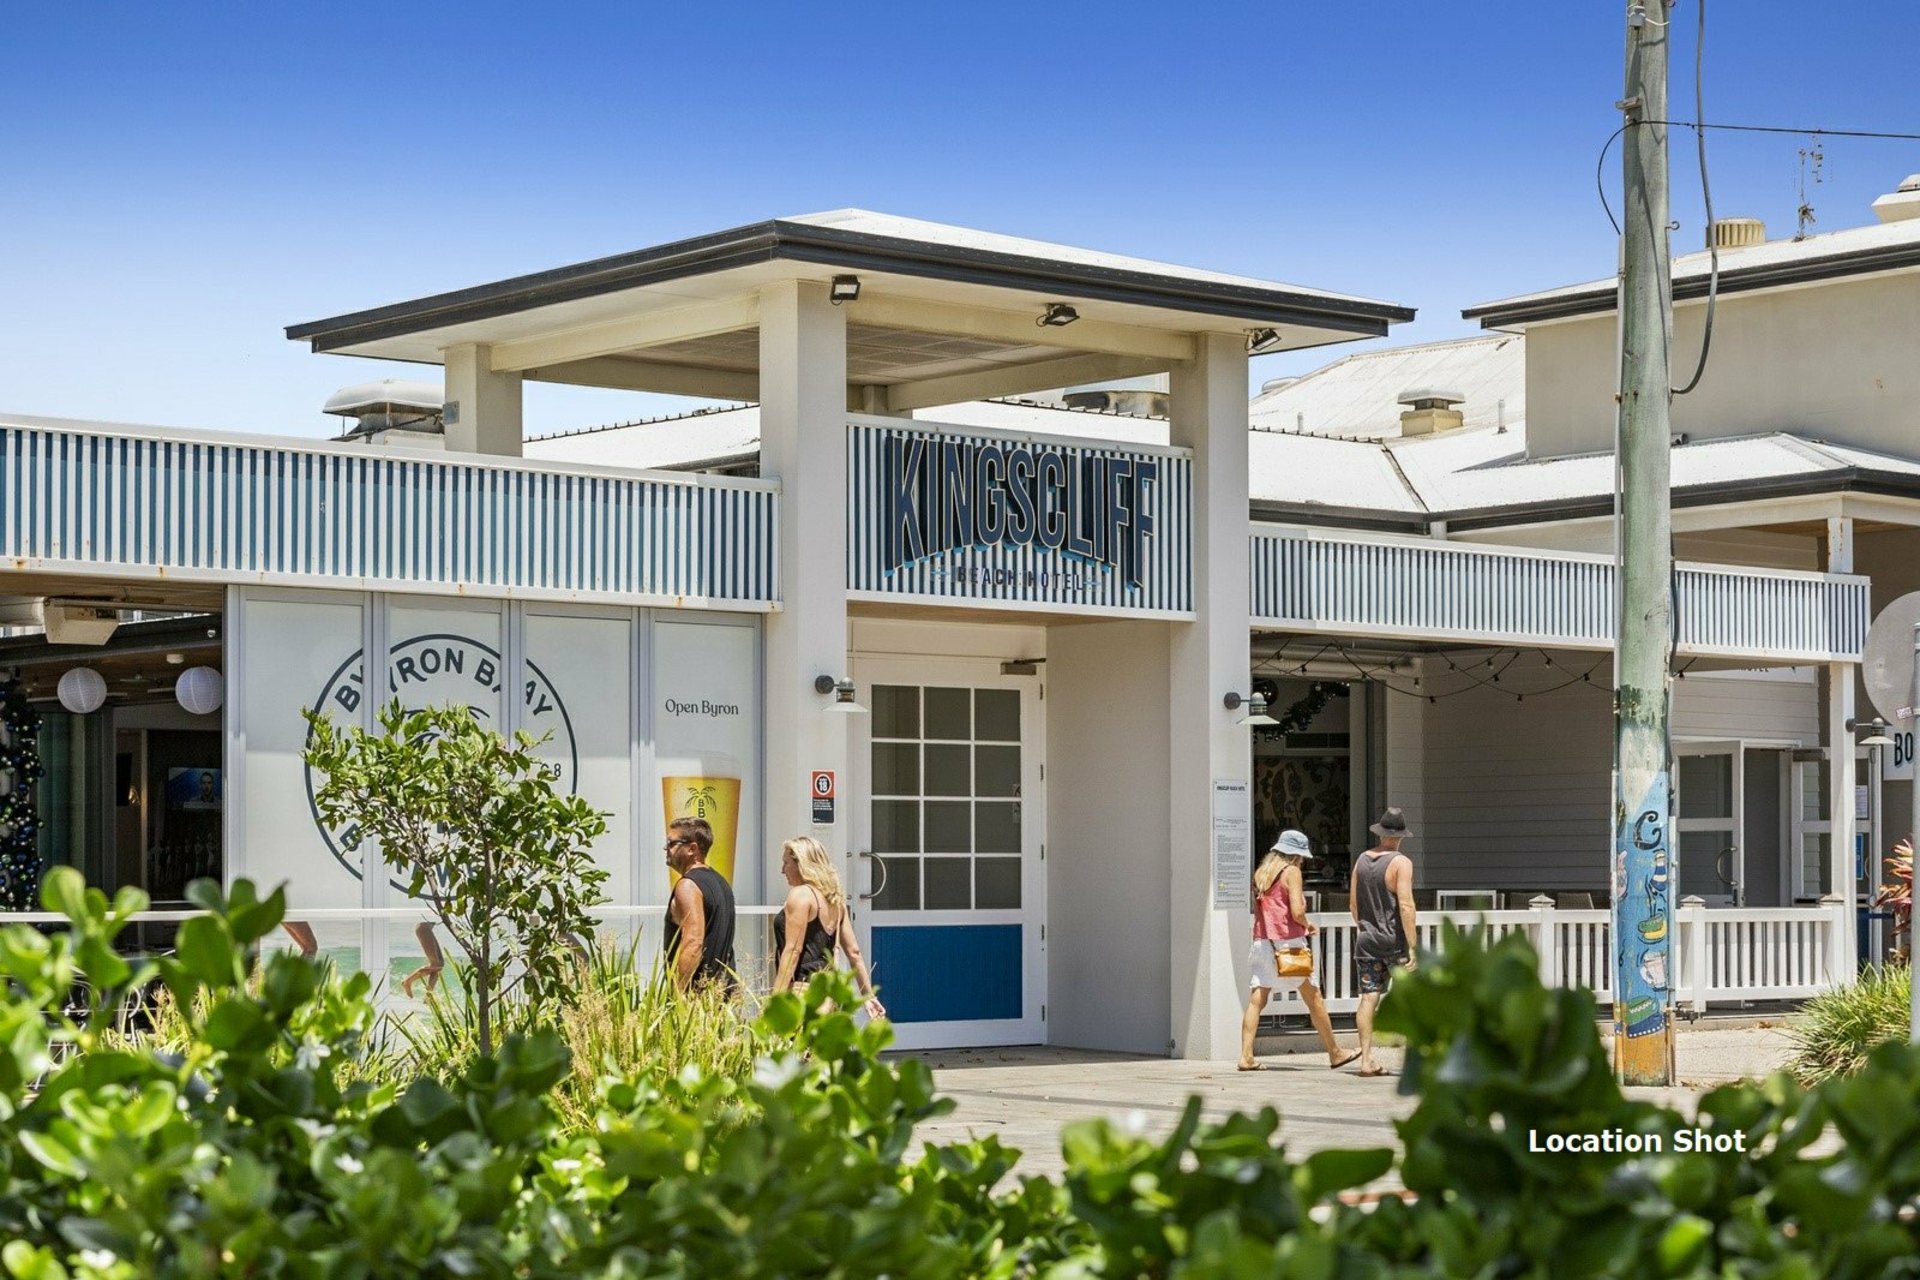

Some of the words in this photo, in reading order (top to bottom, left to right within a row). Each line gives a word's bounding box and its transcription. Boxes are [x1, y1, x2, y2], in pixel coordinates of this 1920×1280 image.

[892, 436, 1157, 587] KINGSCLIFF
[957, 566, 1016, 586] BEACH
[1028, 571, 1083, 591] HOTEL
[474, 657, 552, 716] BAY
[665, 698, 699, 717] Open
[701, 699, 739, 718] Byron
[818, 781, 828, 791] 18
